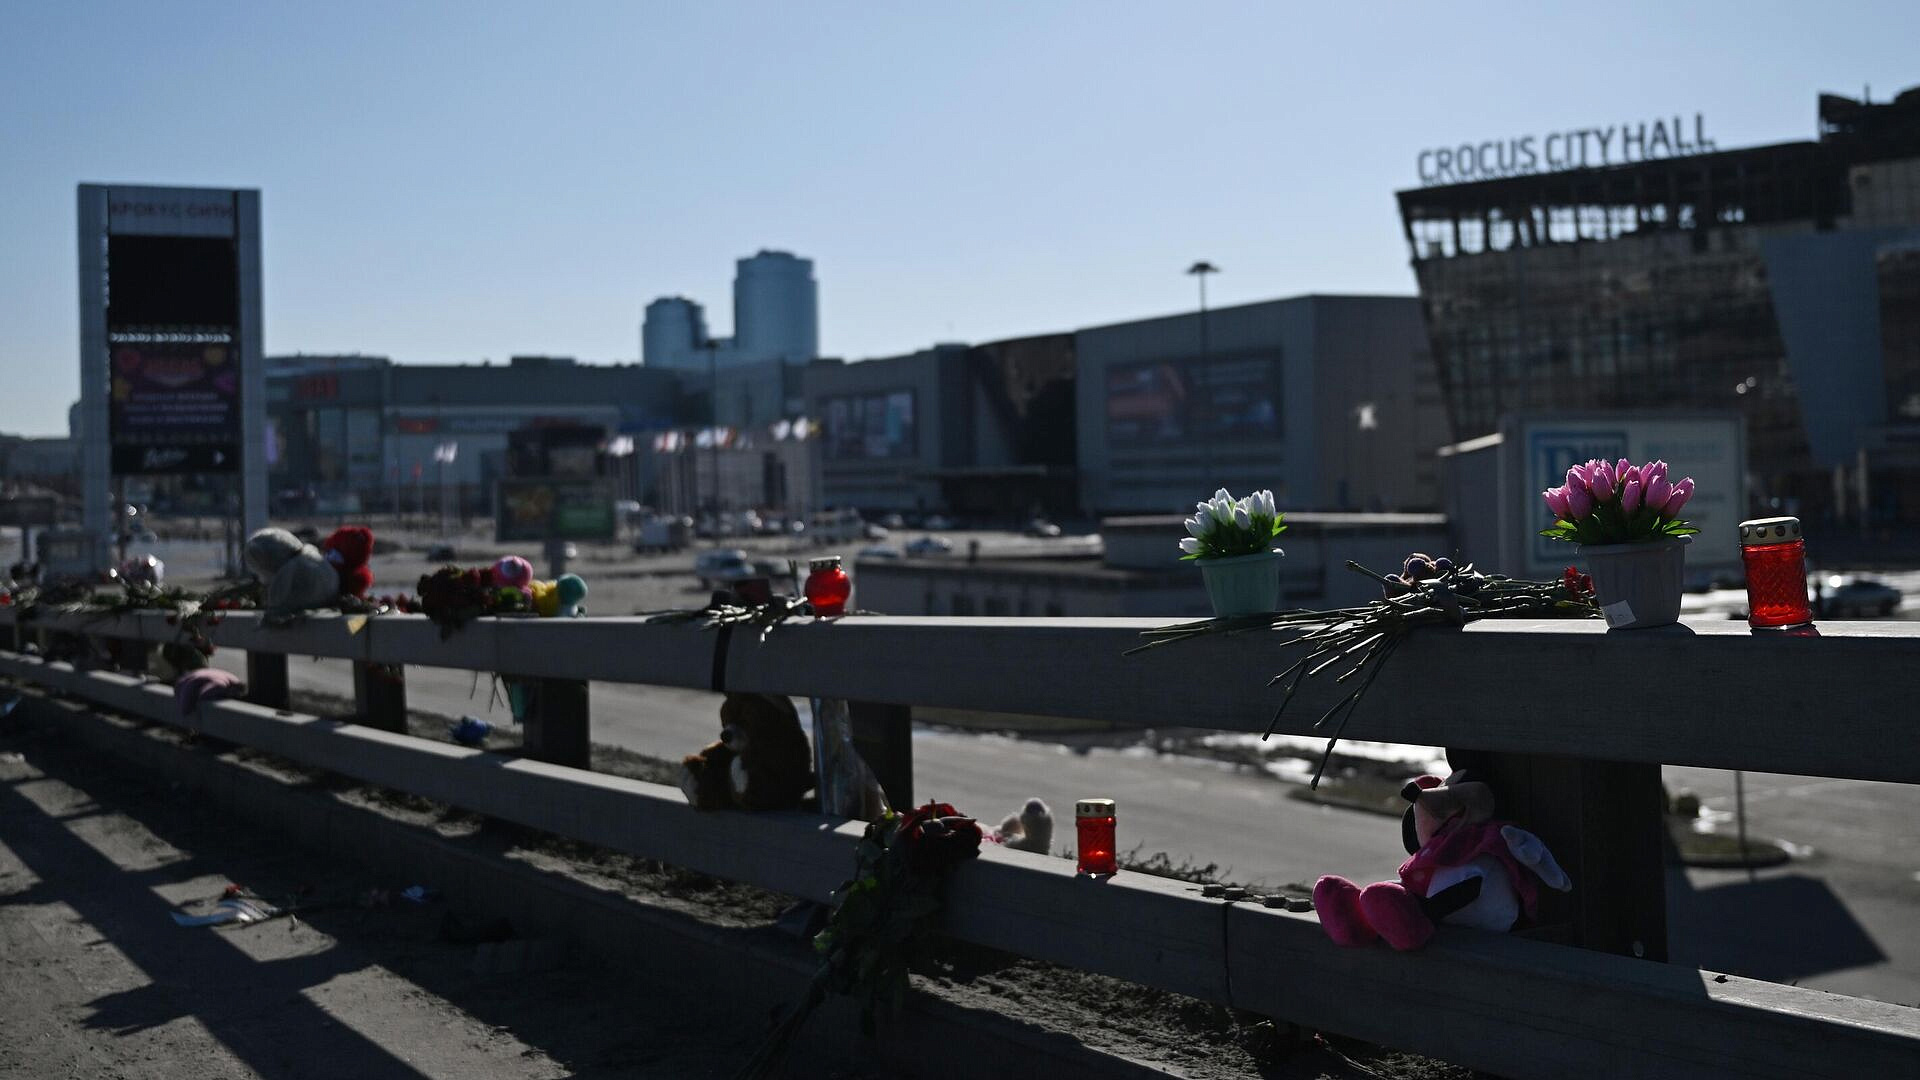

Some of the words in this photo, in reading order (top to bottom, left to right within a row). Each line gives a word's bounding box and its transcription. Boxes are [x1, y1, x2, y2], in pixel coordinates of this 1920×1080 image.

[1417, 136, 1537, 182] CROCUS
[1545, 126, 1614, 168] CITY
[1621, 112, 1715, 161] HALL
